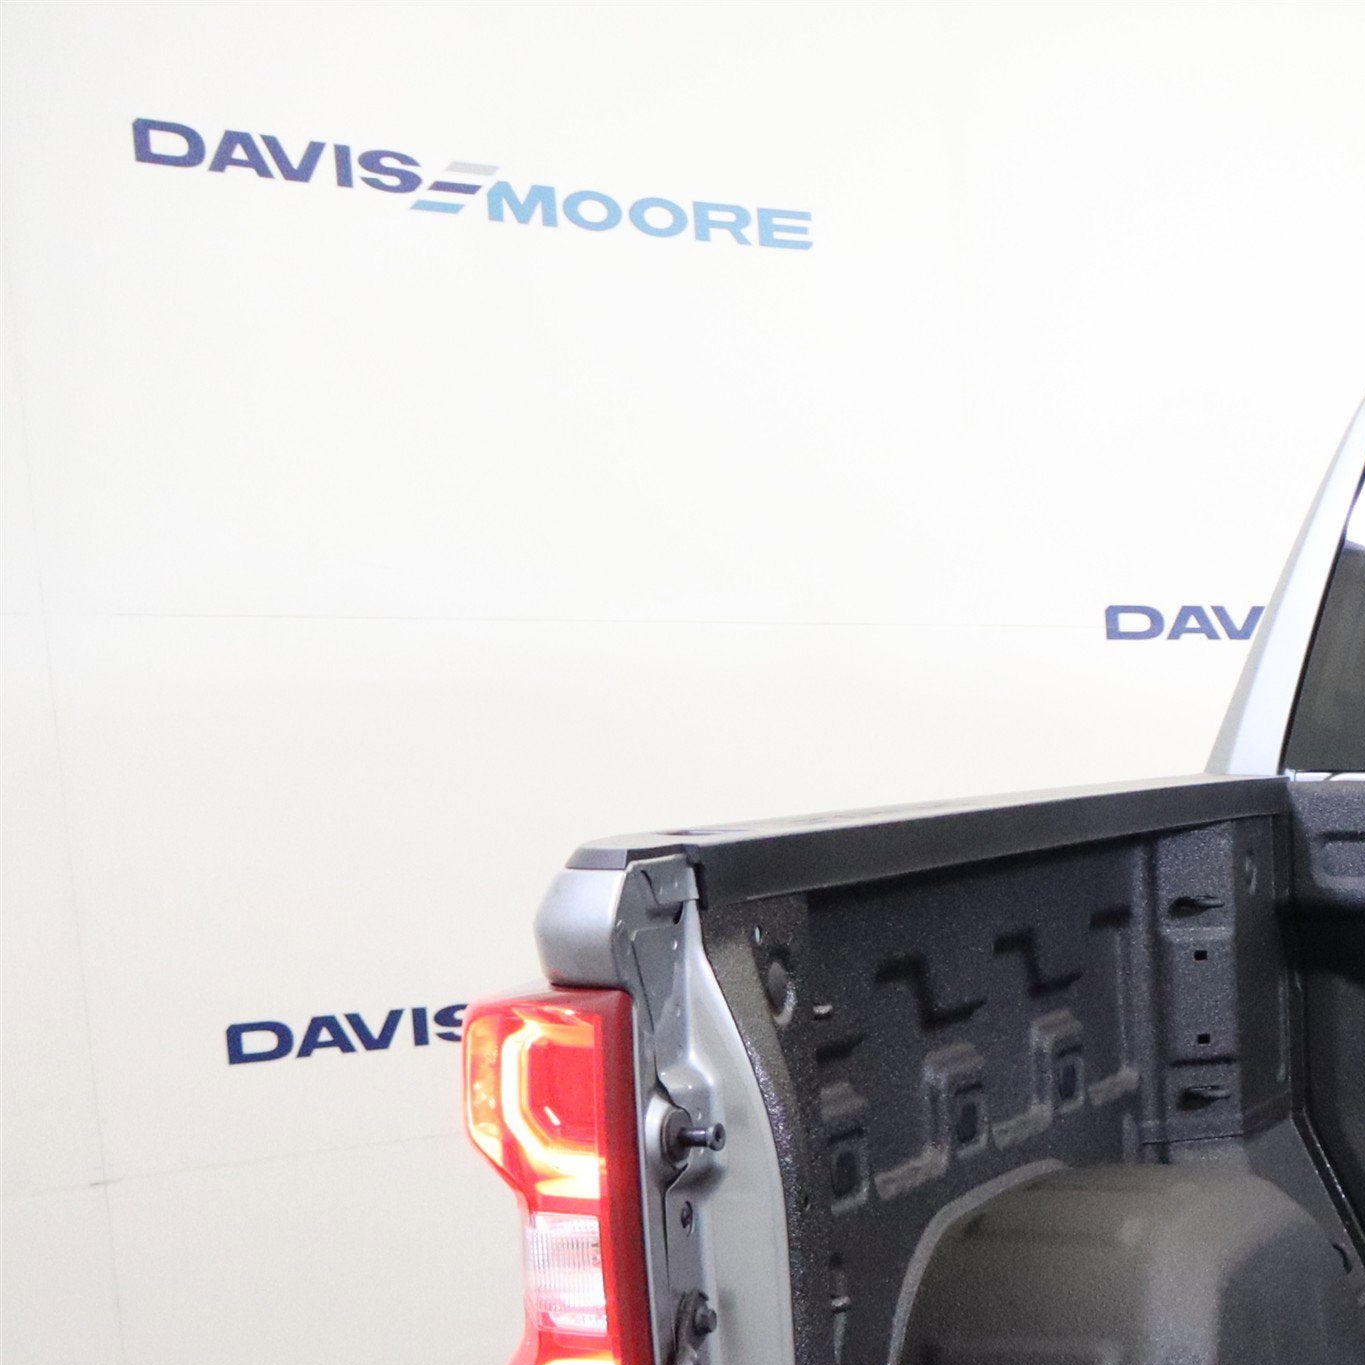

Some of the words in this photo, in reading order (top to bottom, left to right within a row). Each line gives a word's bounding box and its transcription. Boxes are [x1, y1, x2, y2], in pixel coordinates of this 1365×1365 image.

[132, 117, 424, 194] DAVIS
[486, 180, 814, 251] MOORE
[1105, 605, 1265, 640] DAV
